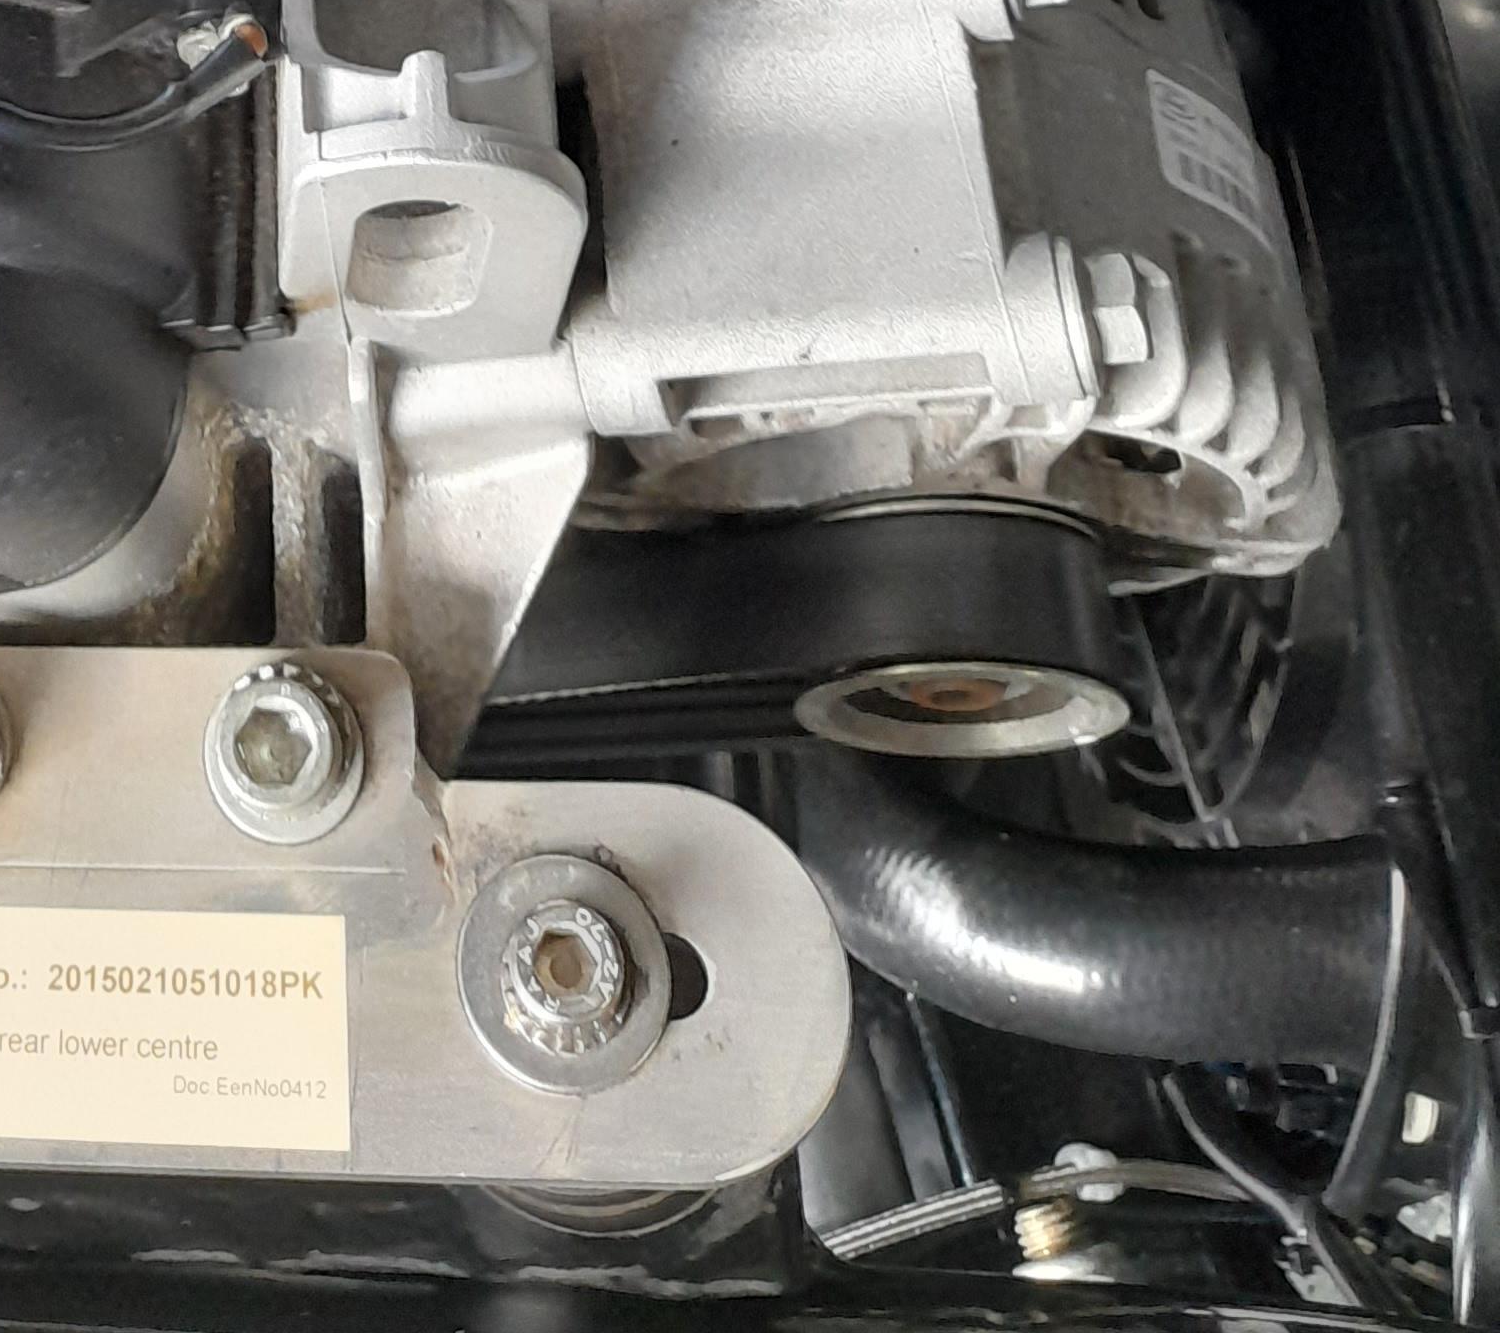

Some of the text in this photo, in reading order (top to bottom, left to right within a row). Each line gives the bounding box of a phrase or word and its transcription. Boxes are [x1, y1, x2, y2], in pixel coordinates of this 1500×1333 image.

[47, 963, 324, 1000] 2015021051018PK
[57, 1028, 129, 1057] lower
[136, 1034, 219, 1061] centre
[172, 1075, 328, 1100] Doc EenNo0412
